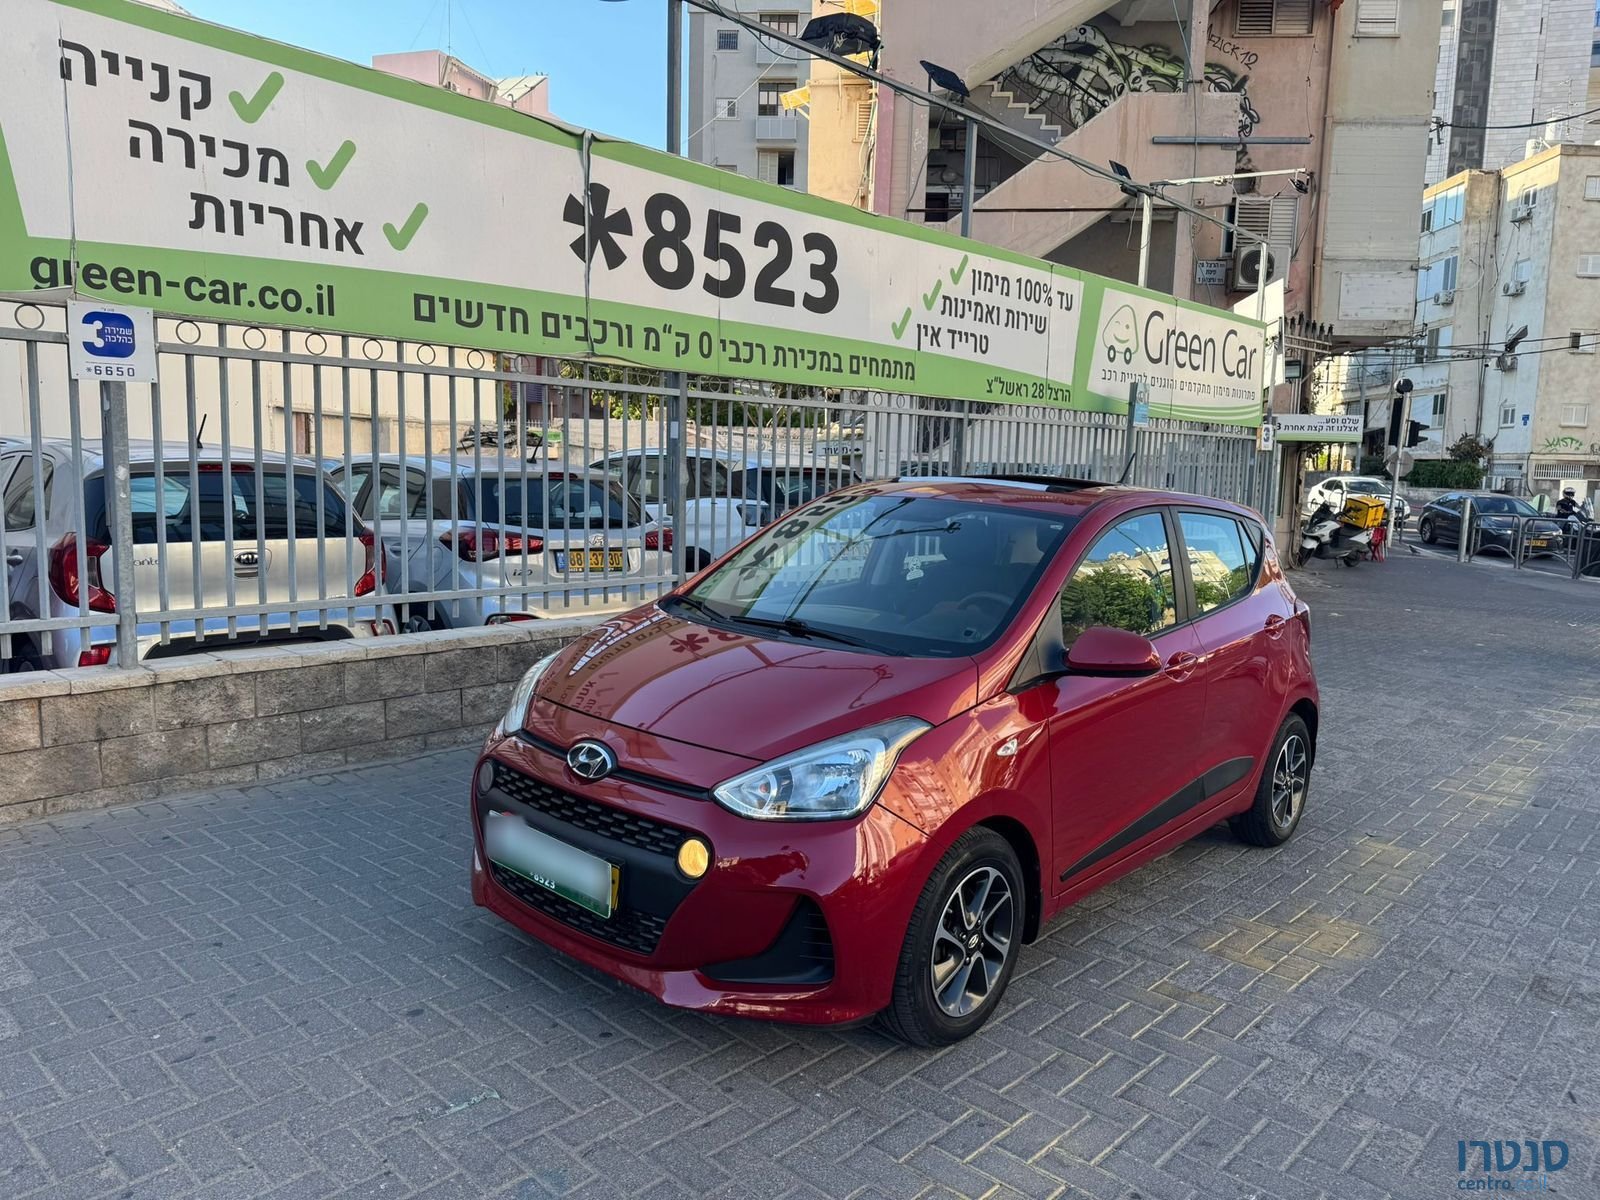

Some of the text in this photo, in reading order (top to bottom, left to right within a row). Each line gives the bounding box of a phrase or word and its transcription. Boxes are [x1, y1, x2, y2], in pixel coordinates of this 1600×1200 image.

[59, 38, 212, 121] קנייה
[129, 119, 289, 187] מכירה
[189, 192, 364, 256] אחריות
[30, 256, 335, 317] green-car.co.il
[972, 269, 1074, 311] עד 100% מימון
[414, 293, 529, 335] חדשים
[941, 295, 1047, 334] שירות ואמינות
[104, 326, 133, 336] שמירה
[542, 311, 633, 348] ורכבים
[917, 323, 989, 354] טרייד אין
[699, 331, 713, 359] 0
[719, 338, 766, 365] רכבי
[773, 345, 843, 373] במכירת
[1144, 310, 1257, 380] Green Car
[849, 353, 915, 381] מתמחים
[1102, 368, 1118, 382] רכב
[1032, 383, 1045, 399] 28
[1047, 384, 1071, 402] הרצל
[1151, 376, 1177, 390] והוגנים
[1180, 380, 1211, 396] מתקדמים
[1213, 385, 1230, 398] מימון
[1232, 388, 1255, 400] פתרונות
[1307, 424, 1324, 432] קצת
